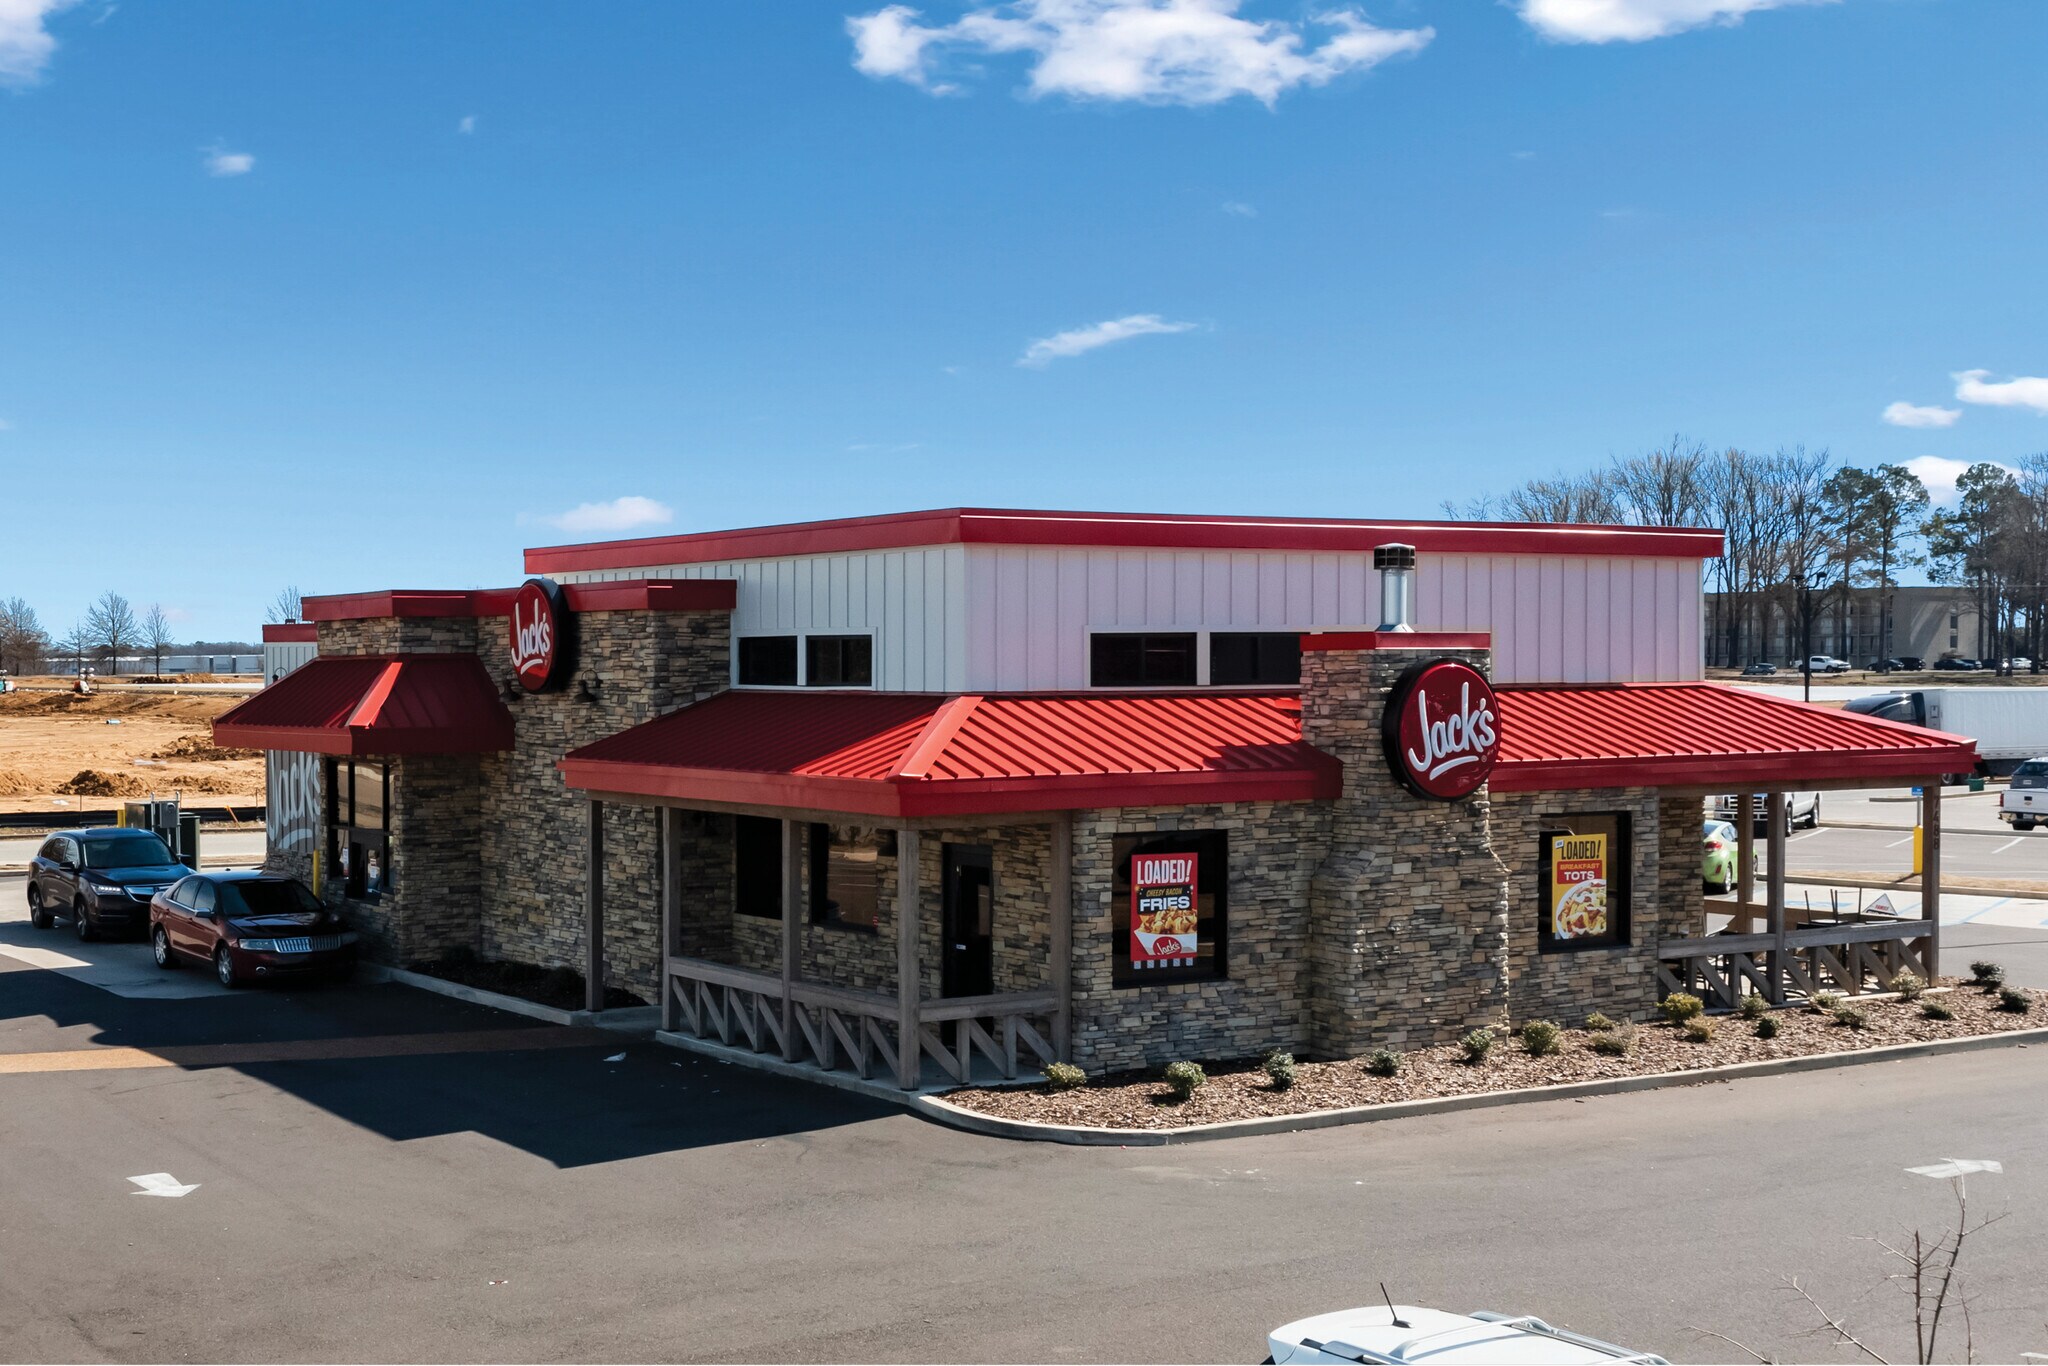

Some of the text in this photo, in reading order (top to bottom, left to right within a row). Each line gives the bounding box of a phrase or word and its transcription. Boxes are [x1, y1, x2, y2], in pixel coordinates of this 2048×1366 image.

[511, 598, 551, 667] Jack's
[1408, 681, 1496, 772] Jack's
[1561, 840, 1602, 860] LOADED!
[1137, 860, 1193, 884] LOADED!
[1564, 871, 1595, 880] TOTS
[1146, 887, 1183, 897] CHEESY BACON
[1140, 896, 1190, 911] FRIES
[1156, 940, 1180, 956] Jack's
